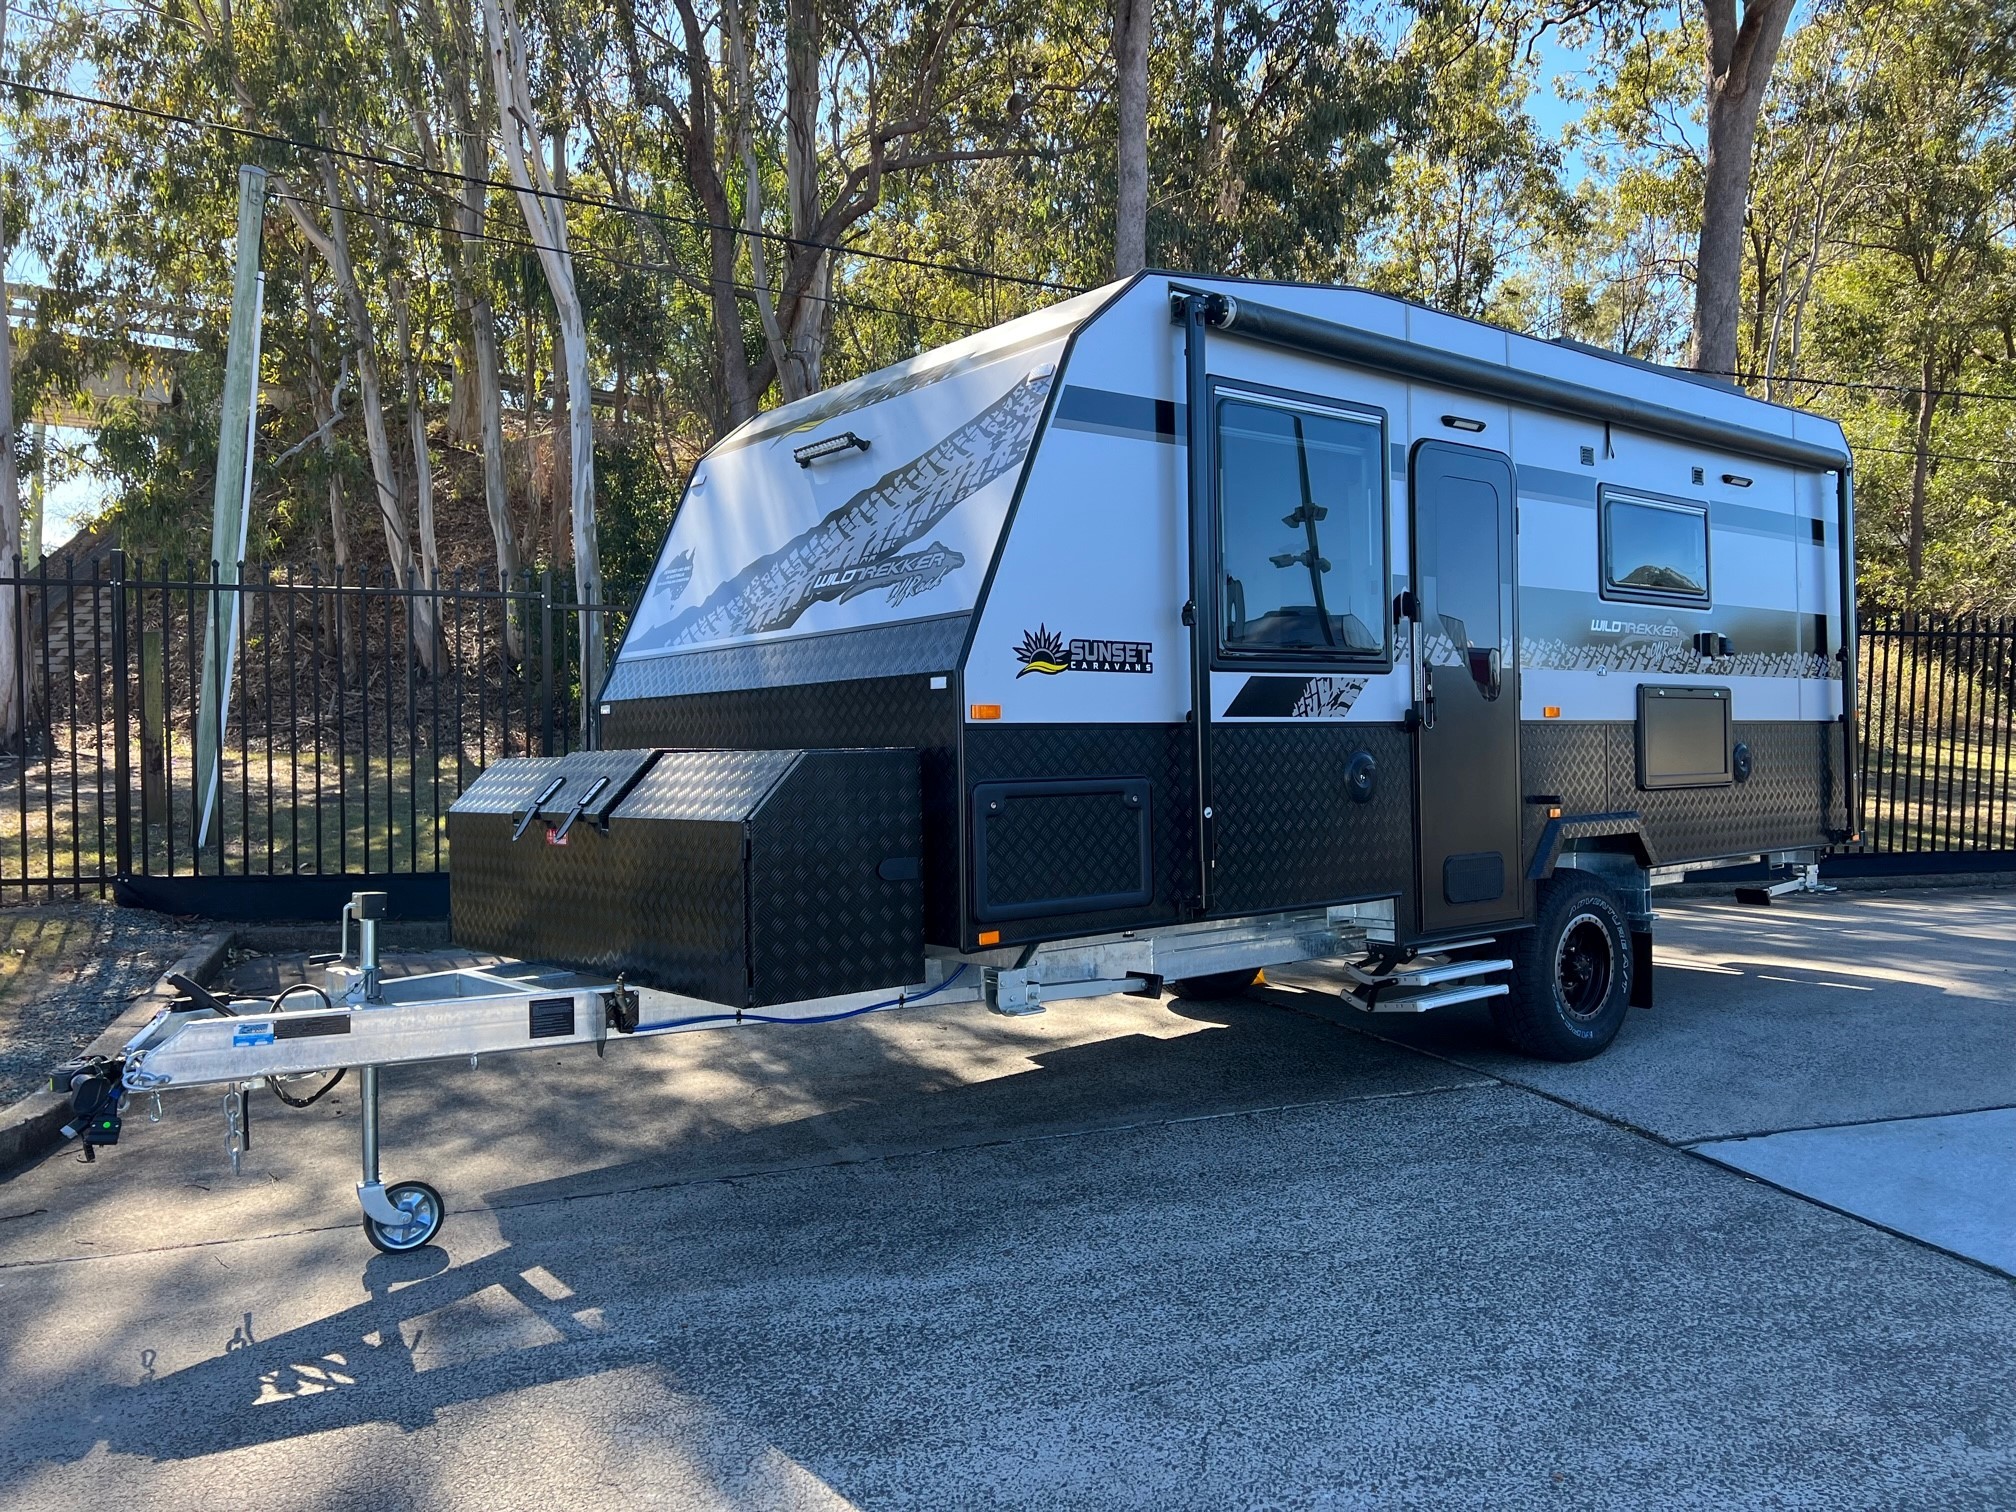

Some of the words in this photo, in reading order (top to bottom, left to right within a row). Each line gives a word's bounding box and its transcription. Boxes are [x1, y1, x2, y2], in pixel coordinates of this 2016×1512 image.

[814, 552, 947, 588] WILDTREKKER
[1591, 619, 1679, 637] WILDTREKKER
[1071, 641, 1151, 663] SUNSET
[1070, 661, 1152, 672] CARAVANS
[1569, 897, 1628, 950] ADVENTURE
